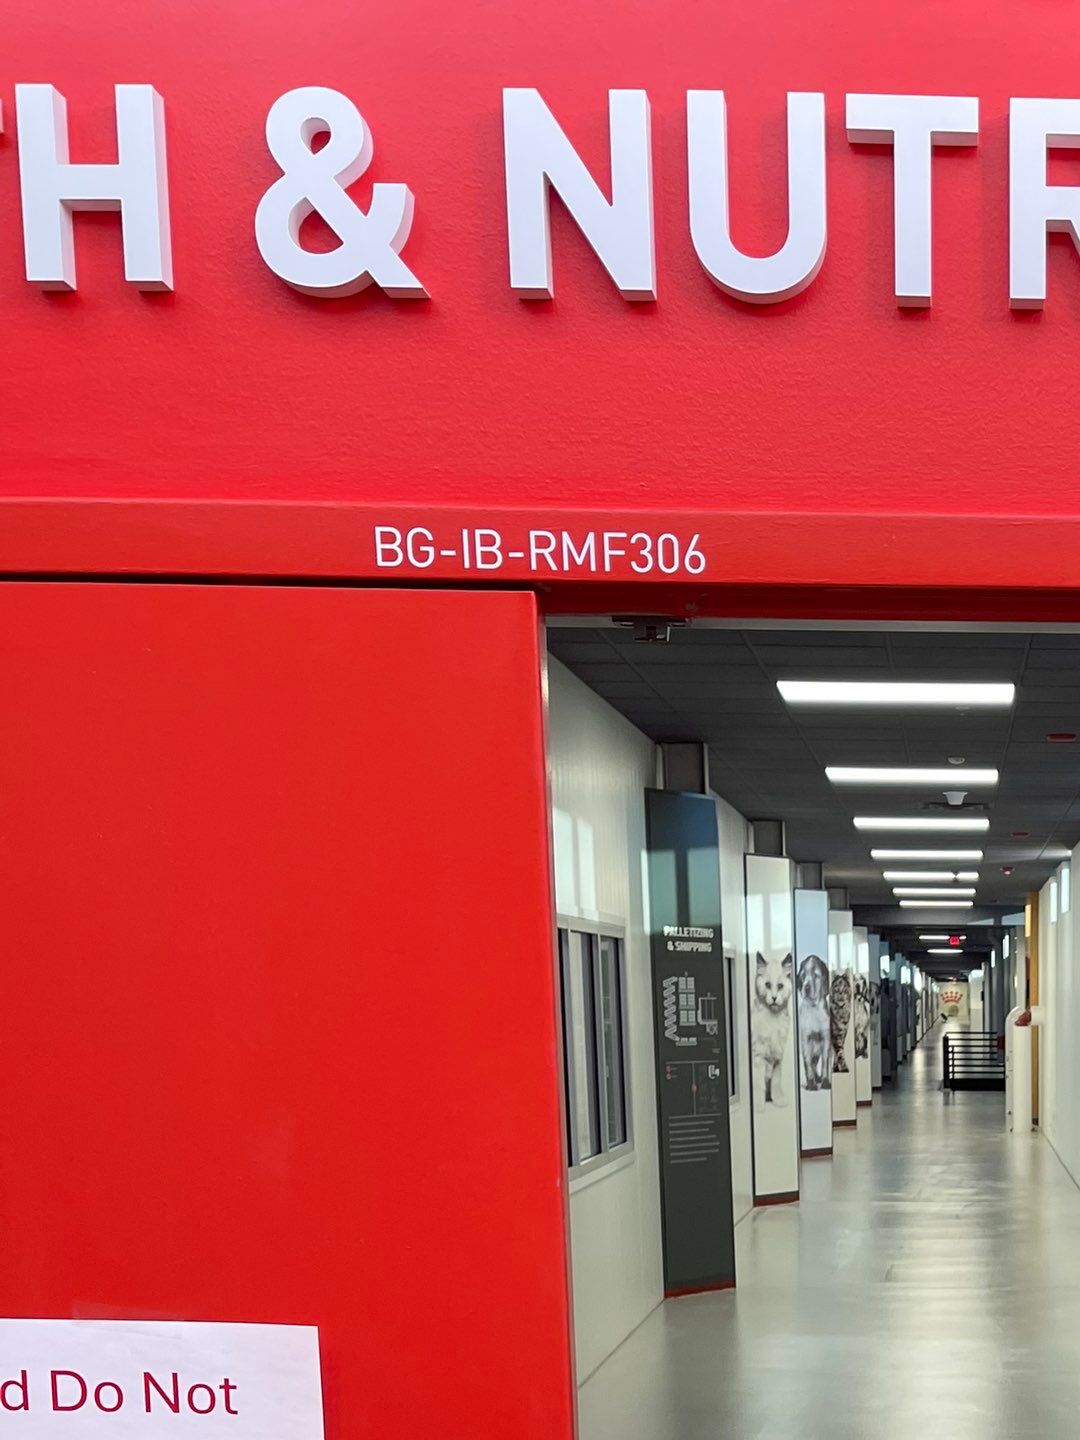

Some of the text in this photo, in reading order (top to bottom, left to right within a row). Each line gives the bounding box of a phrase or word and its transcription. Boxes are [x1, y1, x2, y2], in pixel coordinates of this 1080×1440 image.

[0, 83, 173, 290] H
[255, 86, 430, 298] &
[374, 525, 706, 574] BG-IB-RMF306
[663, 925, 714, 939] PALLETIZING
[674, 941, 712, 952] SHIPPING
[50, 1370, 124, 1413] Do
[143, 1372, 239, 1415] Not
